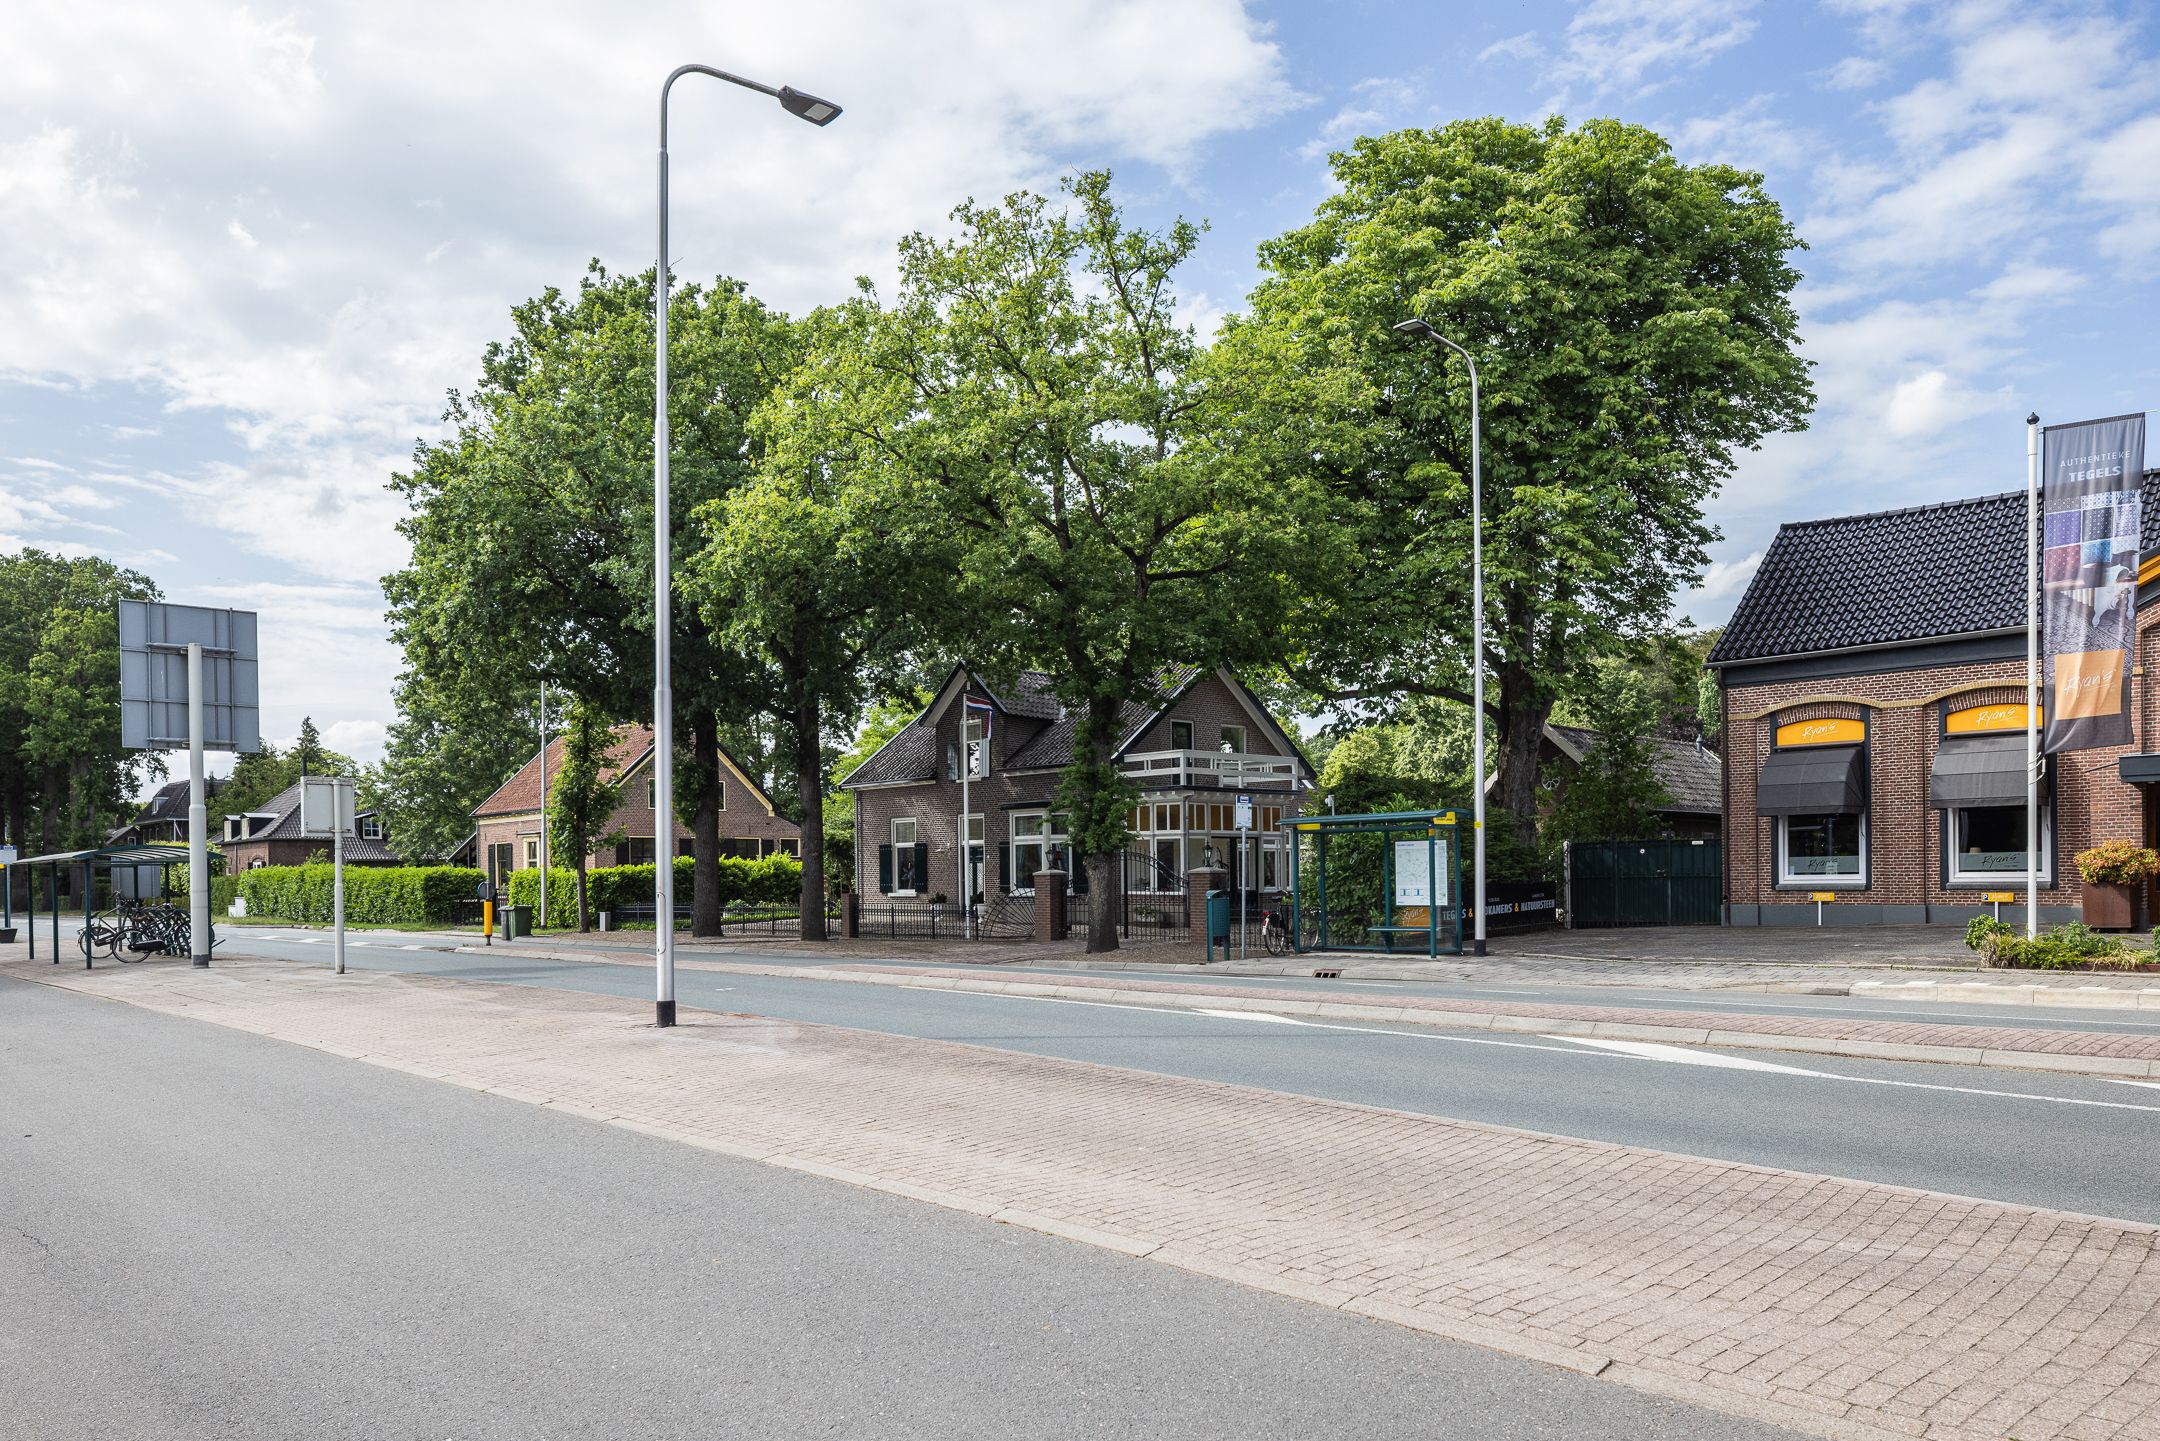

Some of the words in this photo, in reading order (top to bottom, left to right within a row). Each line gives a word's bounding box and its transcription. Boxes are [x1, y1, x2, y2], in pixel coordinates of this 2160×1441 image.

[2060, 450, 2131, 468] AUTHENTIEKE
[2069, 465, 2121, 482] TEGELS
[2063, 669, 2114, 698] Ryan's
[1976, 705, 2016, 727] Ryan's
[1802, 721, 1836, 742] Ryan's
[1981, 853, 2017, 869] Ryan's
[1442, 910, 1467, 921] TEGS
[1514, 902, 1519, 912] &
